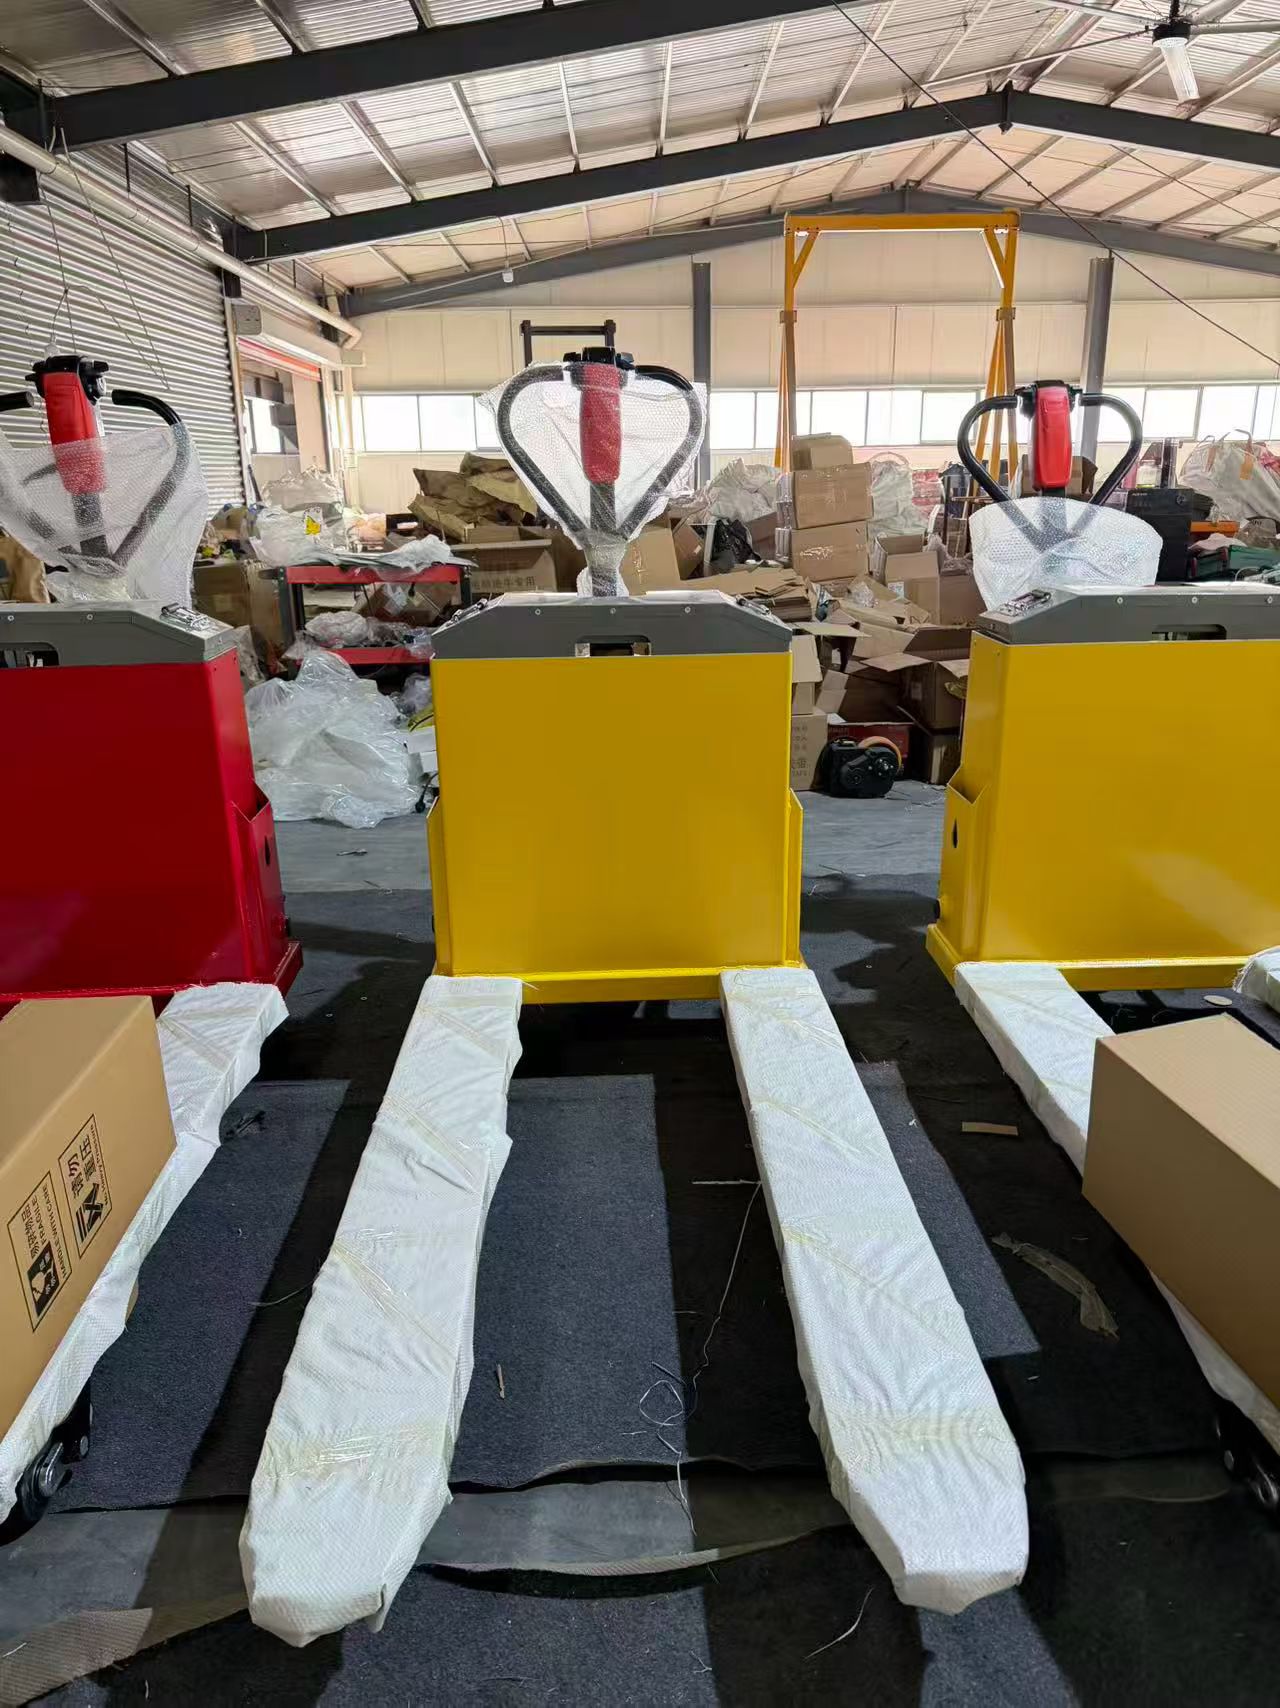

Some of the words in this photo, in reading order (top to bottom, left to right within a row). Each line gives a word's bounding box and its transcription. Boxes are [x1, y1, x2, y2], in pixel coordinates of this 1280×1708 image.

[65, 1152, 84, 1200] 请勿
[79, 1133, 96, 1182] 重压
[31, 1195, 47, 1246] FRAGILE
[42, 1182, 52, 1213] CARE
[21, 1203, 40, 1260] 易碎物品
[48, 1211, 57, 1239] WITH
[54, 1236, 67, 1279] HANDLE
